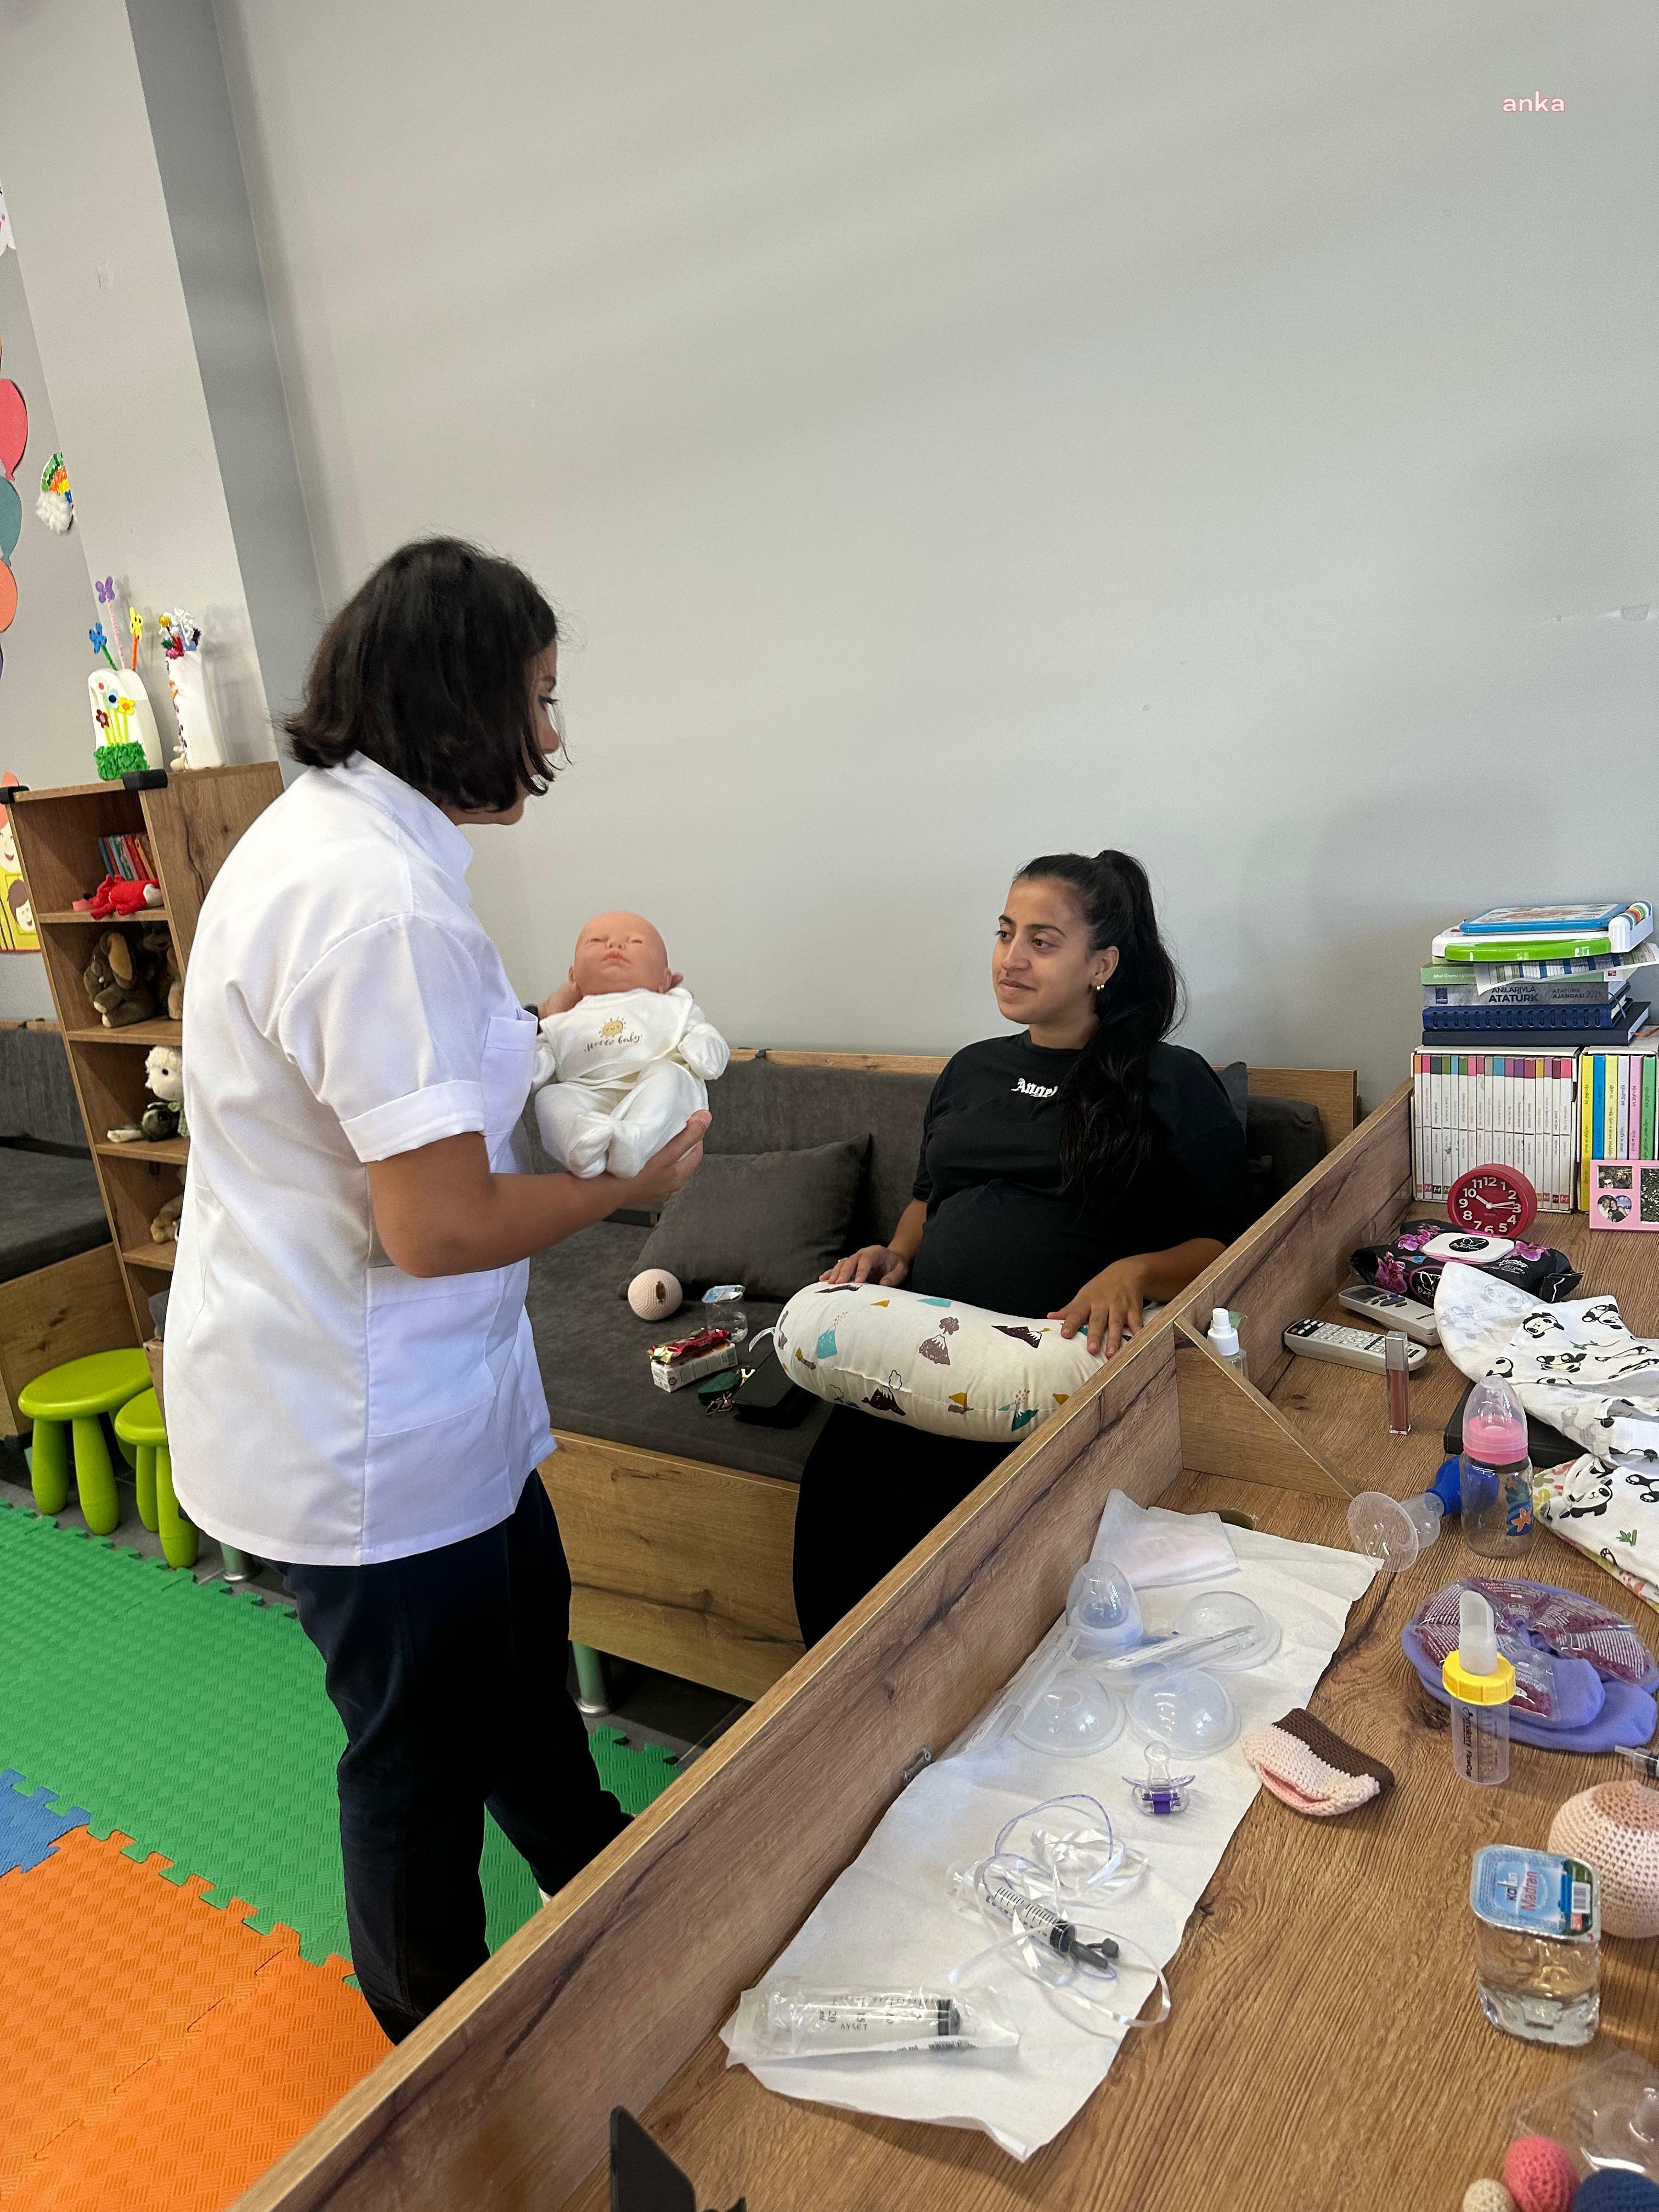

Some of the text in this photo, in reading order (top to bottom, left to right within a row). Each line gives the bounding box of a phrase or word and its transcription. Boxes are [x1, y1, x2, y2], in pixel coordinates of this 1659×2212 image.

[1472, 1179, 1482, 1189] 11
[1483, 1177, 1497, 1187] 12
[1500, 1181, 1506, 1190] 1
[1463, 1188, 1477, 1198] 10
[1508, 1190, 1517, 1200] 2
[1458, 1198, 1469, 1208] 9
[1512, 1203, 1521, 1214] 3
[1463, 1210, 1472, 1221] 8
[1506, 1215, 1517, 1225] 4
[1474, 1220, 1482, 1230] 7
[1484, 1225, 1494, 1234] 6
[1498, 1223, 1508, 1232] 5
[1521, 1871, 1538, 1911] Madran
[828, 2010, 837, 2023] 20
[857, 2012, 865, 2023] 15
